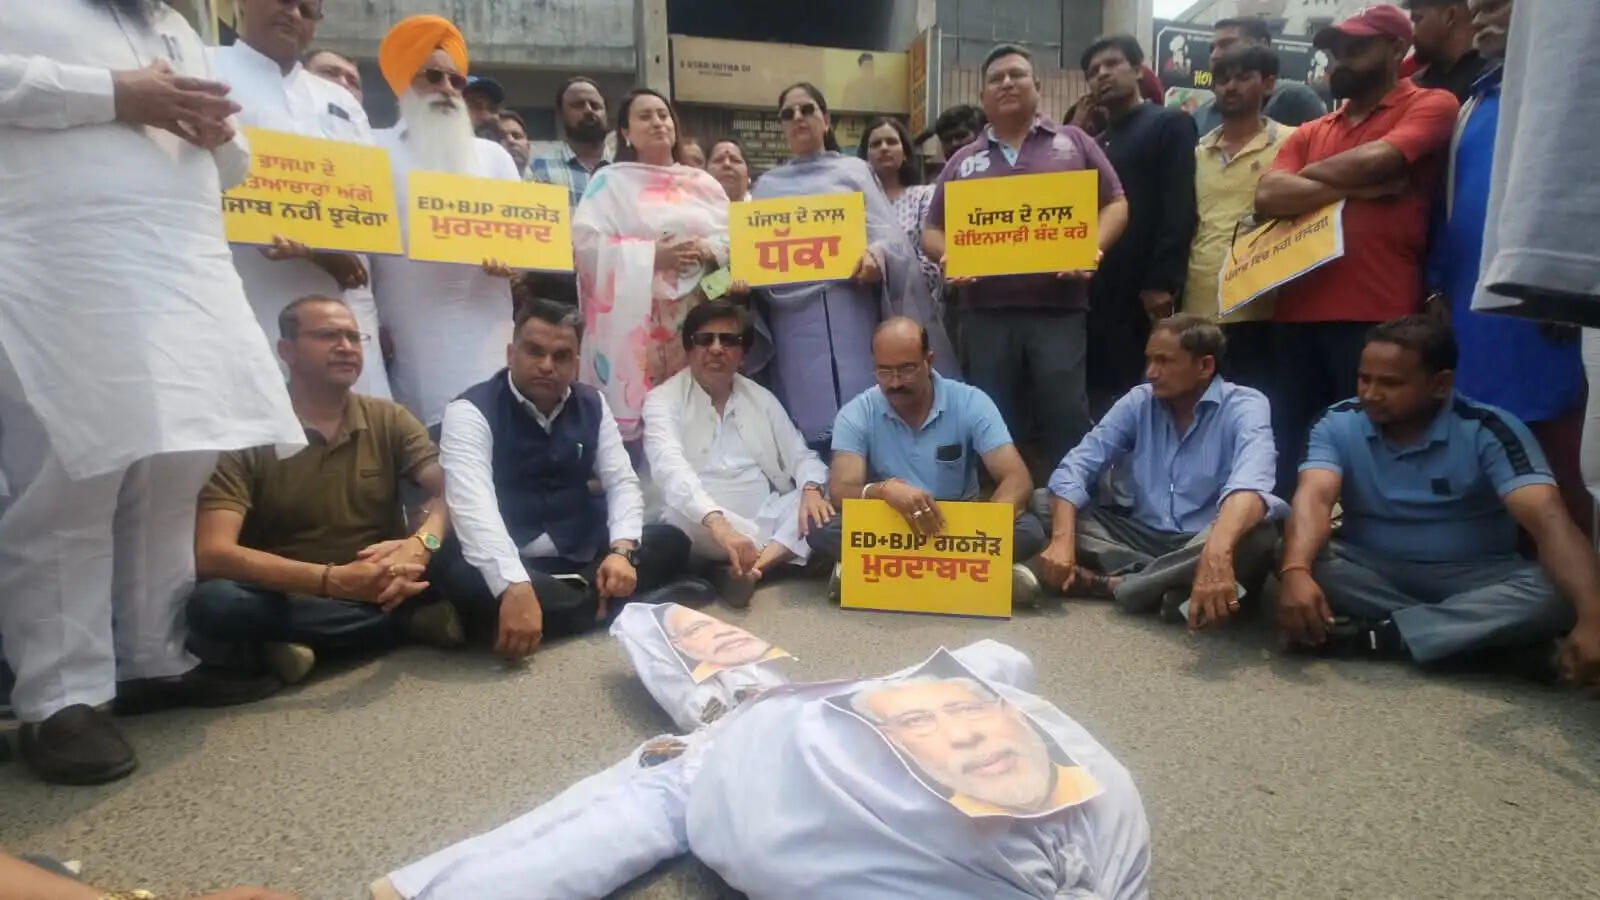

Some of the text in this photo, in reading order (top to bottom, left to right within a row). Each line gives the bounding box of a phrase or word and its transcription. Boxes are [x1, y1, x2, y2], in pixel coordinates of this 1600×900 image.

[258, 155, 336, 177] ਭਾਜਪਾ ਦੇ
[278, 199, 322, 221] ਨਹੀਂ
[327, 204, 388, 229] ਝੁਕੇਗਾ
[417, 196, 560, 224] ED+BJP ਗਠਜੋੜ
[746, 210, 791, 227] ਪੰਜਾਬ
[794, 206, 808, 223] ਦੇ
[967, 207, 1015, 226] ਪੰਜਾਬ
[1018, 204, 1032, 222] ਦੇ
[430, 215, 553, 243] ਮੁਰਦਾਬਾਦ
[1034, 223, 1058, 241] ਬੰਦ
[1063, 221, 1089, 239] ਕਰੋ
[754, 228, 842, 272] ਧੱਕਾ
[850, 529, 1002, 556] ED+BJP ਗਠਜੋੜ
[861, 553, 991, 582] ਮੁਰਦਾਬਾਦ
